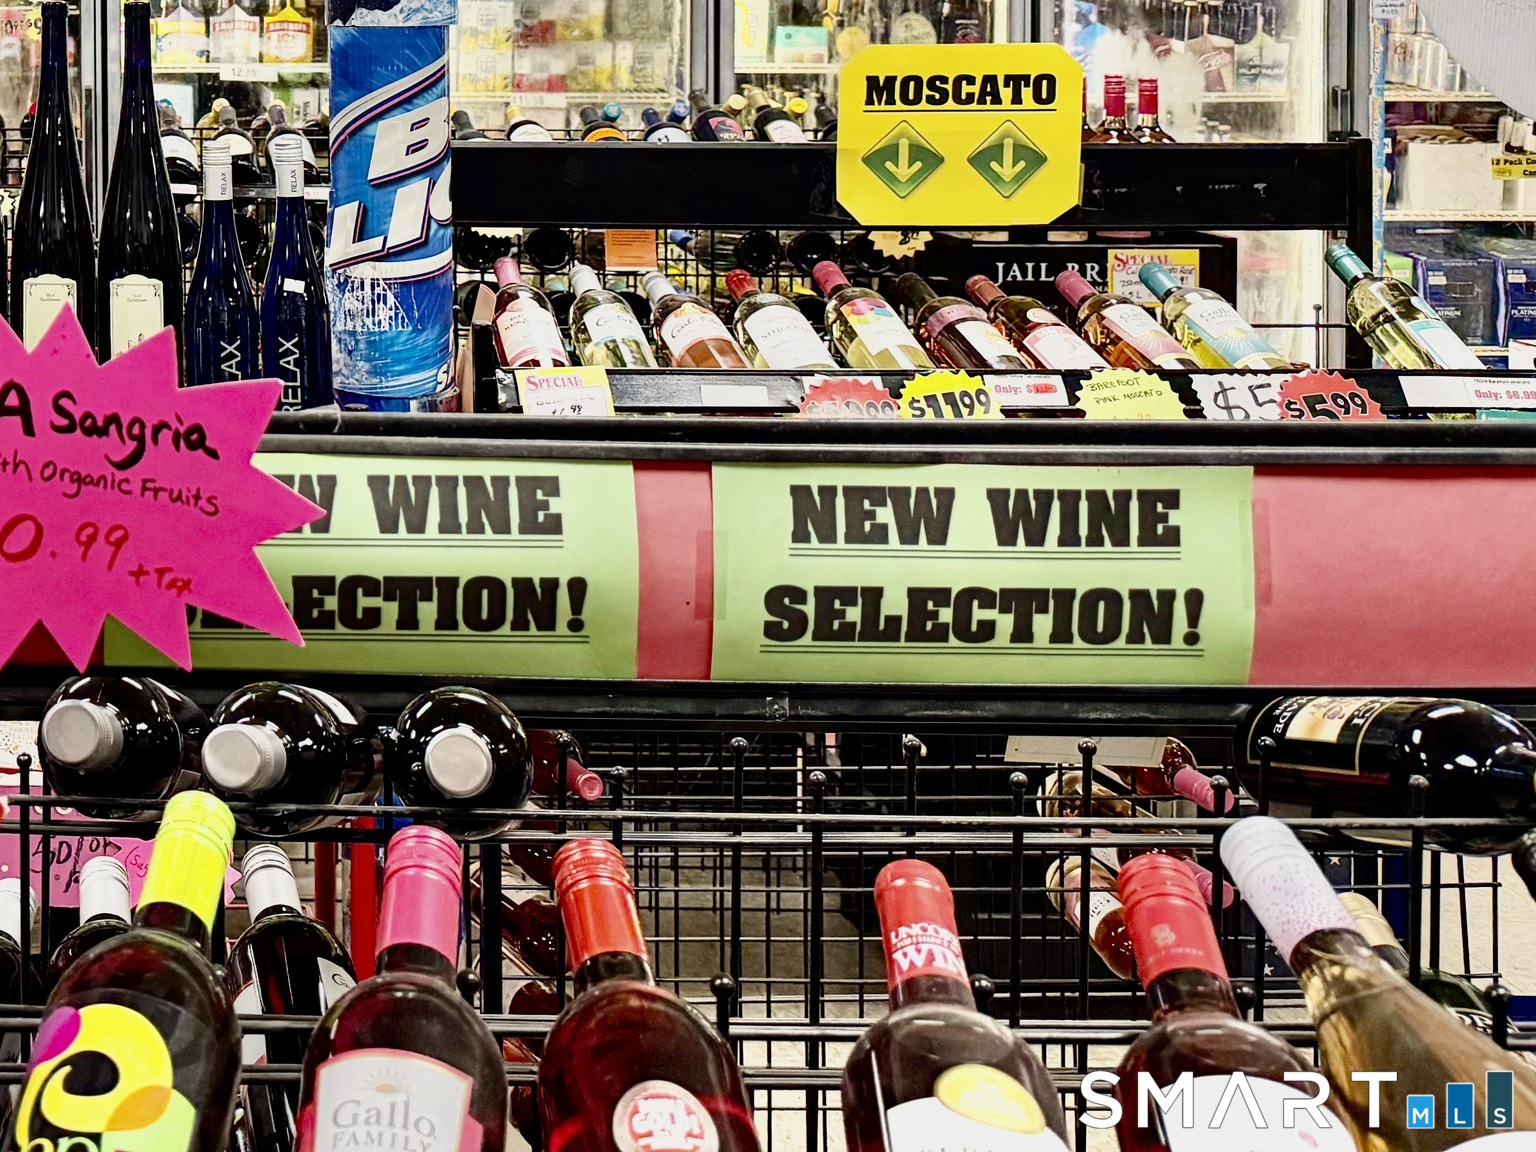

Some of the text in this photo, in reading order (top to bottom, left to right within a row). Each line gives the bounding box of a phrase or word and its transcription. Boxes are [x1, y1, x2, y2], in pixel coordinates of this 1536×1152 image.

[864, 73, 1057, 107] MOSCATO
[220, 171, 228, 196] RELAX
[995, 262, 1055, 286] JAIL
[527, 375, 583, 392] SPECIAL
[995, 384, 1023, 395] Only:
[1086, 377, 1141, 392] BAREFOOT
[1094, 390, 1163, 405] PINK MOSCATO
[1474, 389, 1503, 400] Only:
[49, 389, 221, 469] Sangria
[140, 476, 221, 517] Fruits
[366, 475, 564, 536] WINE
[790, 483, 1181, 549] NEW WINE
[274, 575, 589, 634] ECTION!
[762, 586, 1206, 646] SELECTION!
[332, 1089, 437, 1139] Gallo
